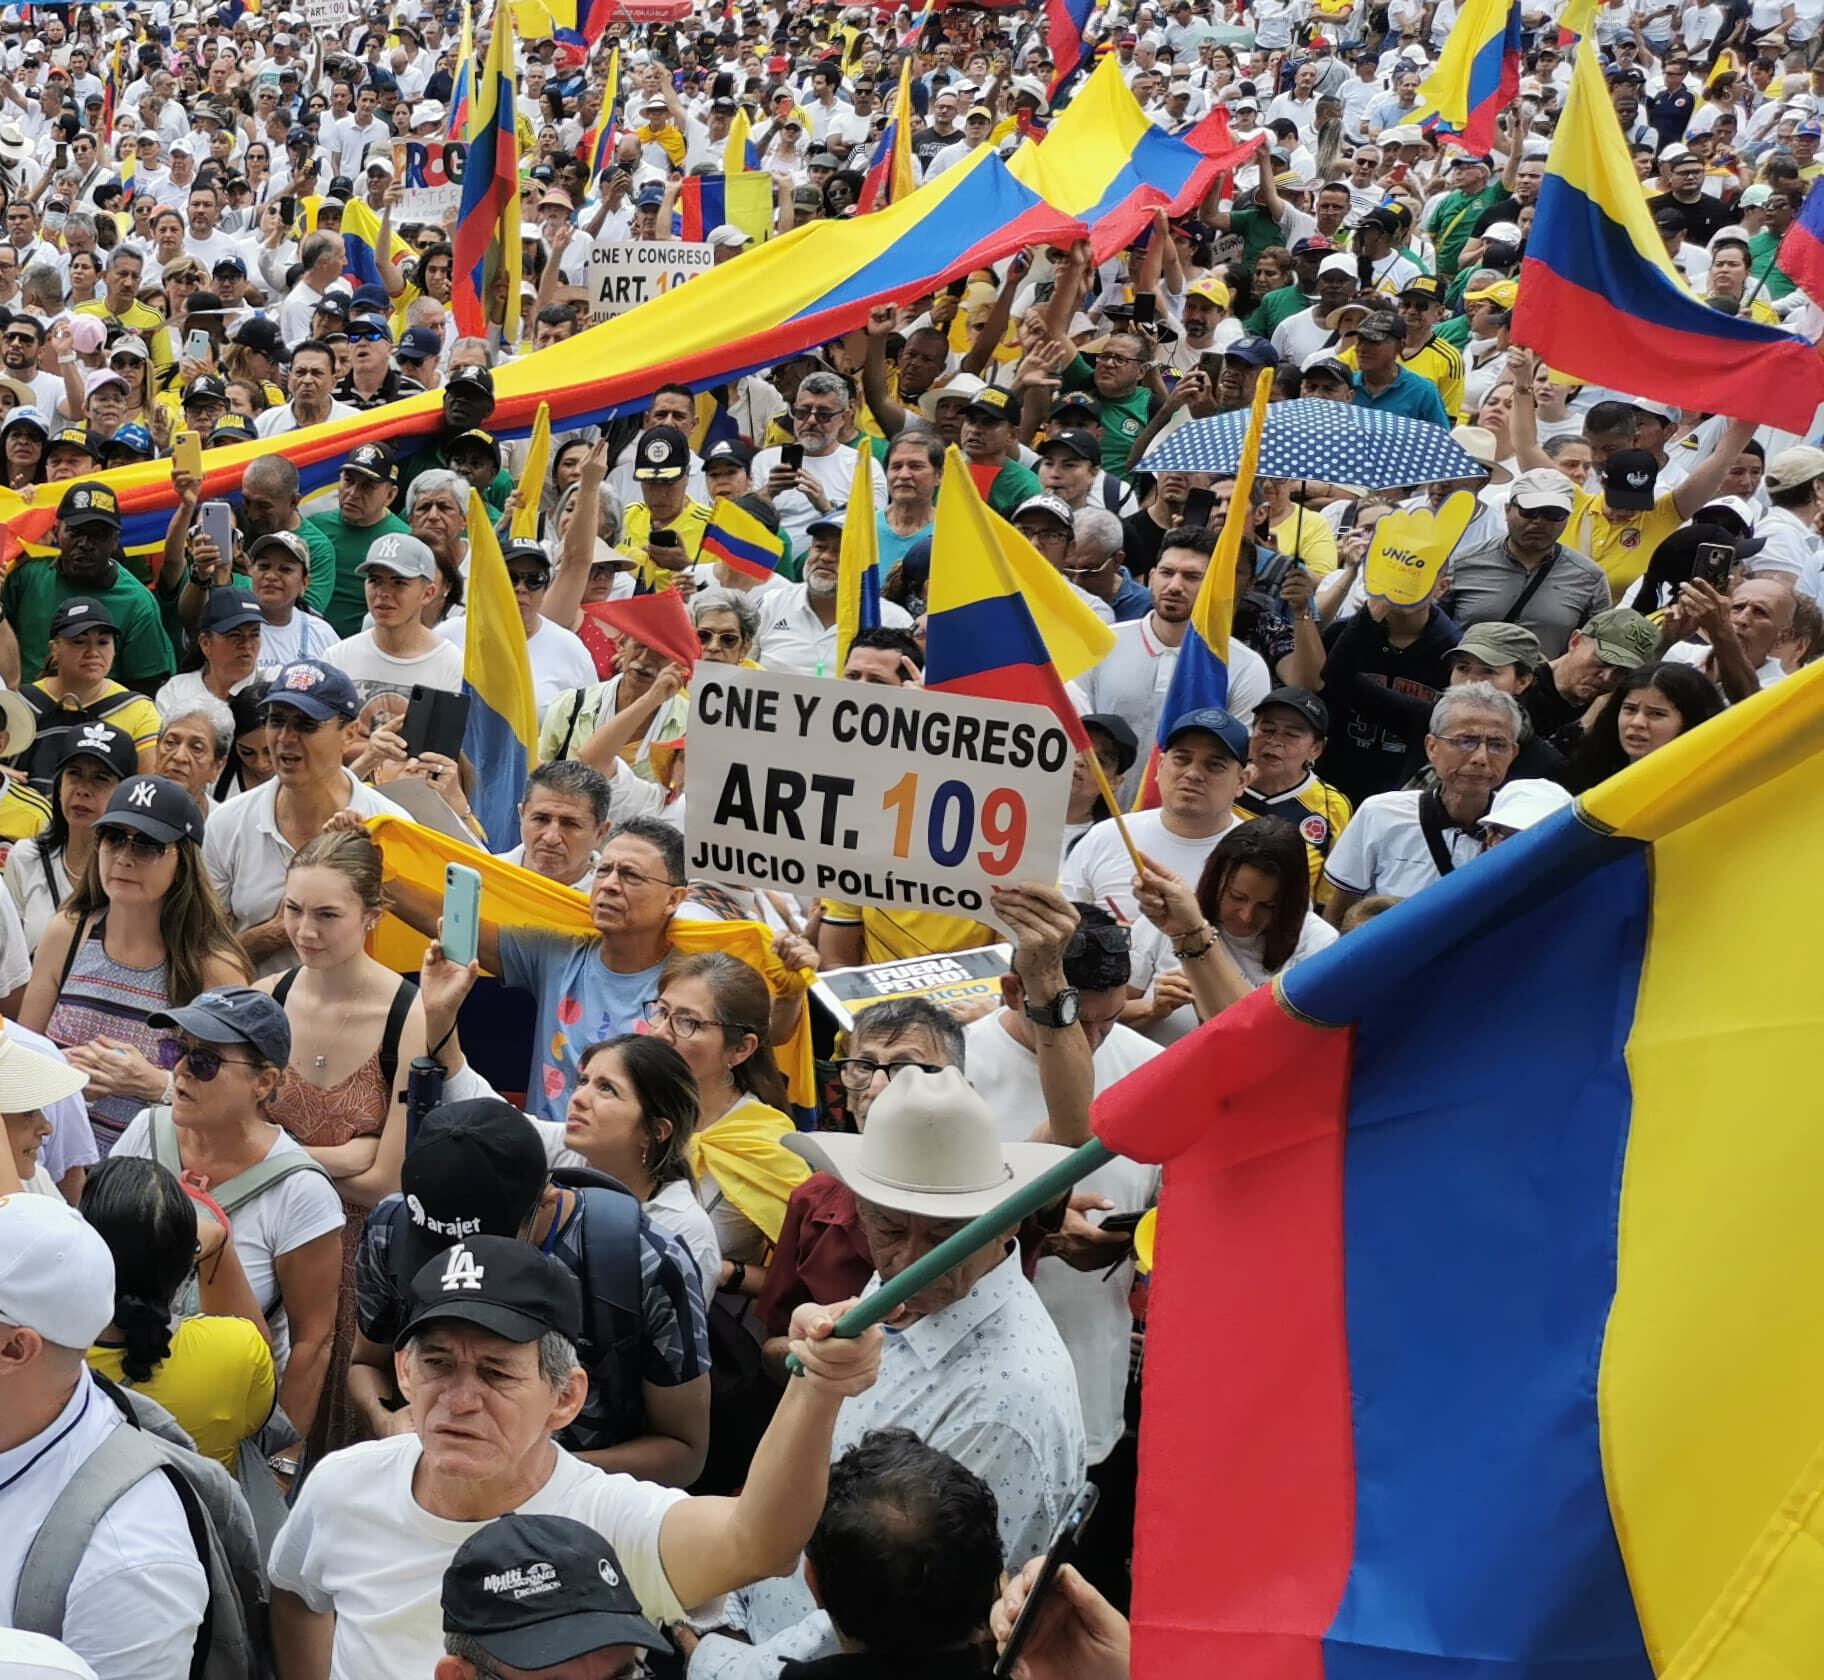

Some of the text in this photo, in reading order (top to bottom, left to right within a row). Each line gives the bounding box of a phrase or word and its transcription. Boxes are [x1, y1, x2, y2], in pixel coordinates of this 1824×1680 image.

[591, 247, 711, 266] CNE Y CONGRESO
[599, 275, 649, 303] ART.
[698, 682, 1068, 773] CNE Y CONGRESO
[713, 762, 1027, 877] ART. 109
[691, 842, 983, 912] JUICIO POLÍTICO
[873, 968, 974, 994] PETRO!
[427, 1216, 480, 1239] arajet
[440, 1243, 484, 1291] LA
